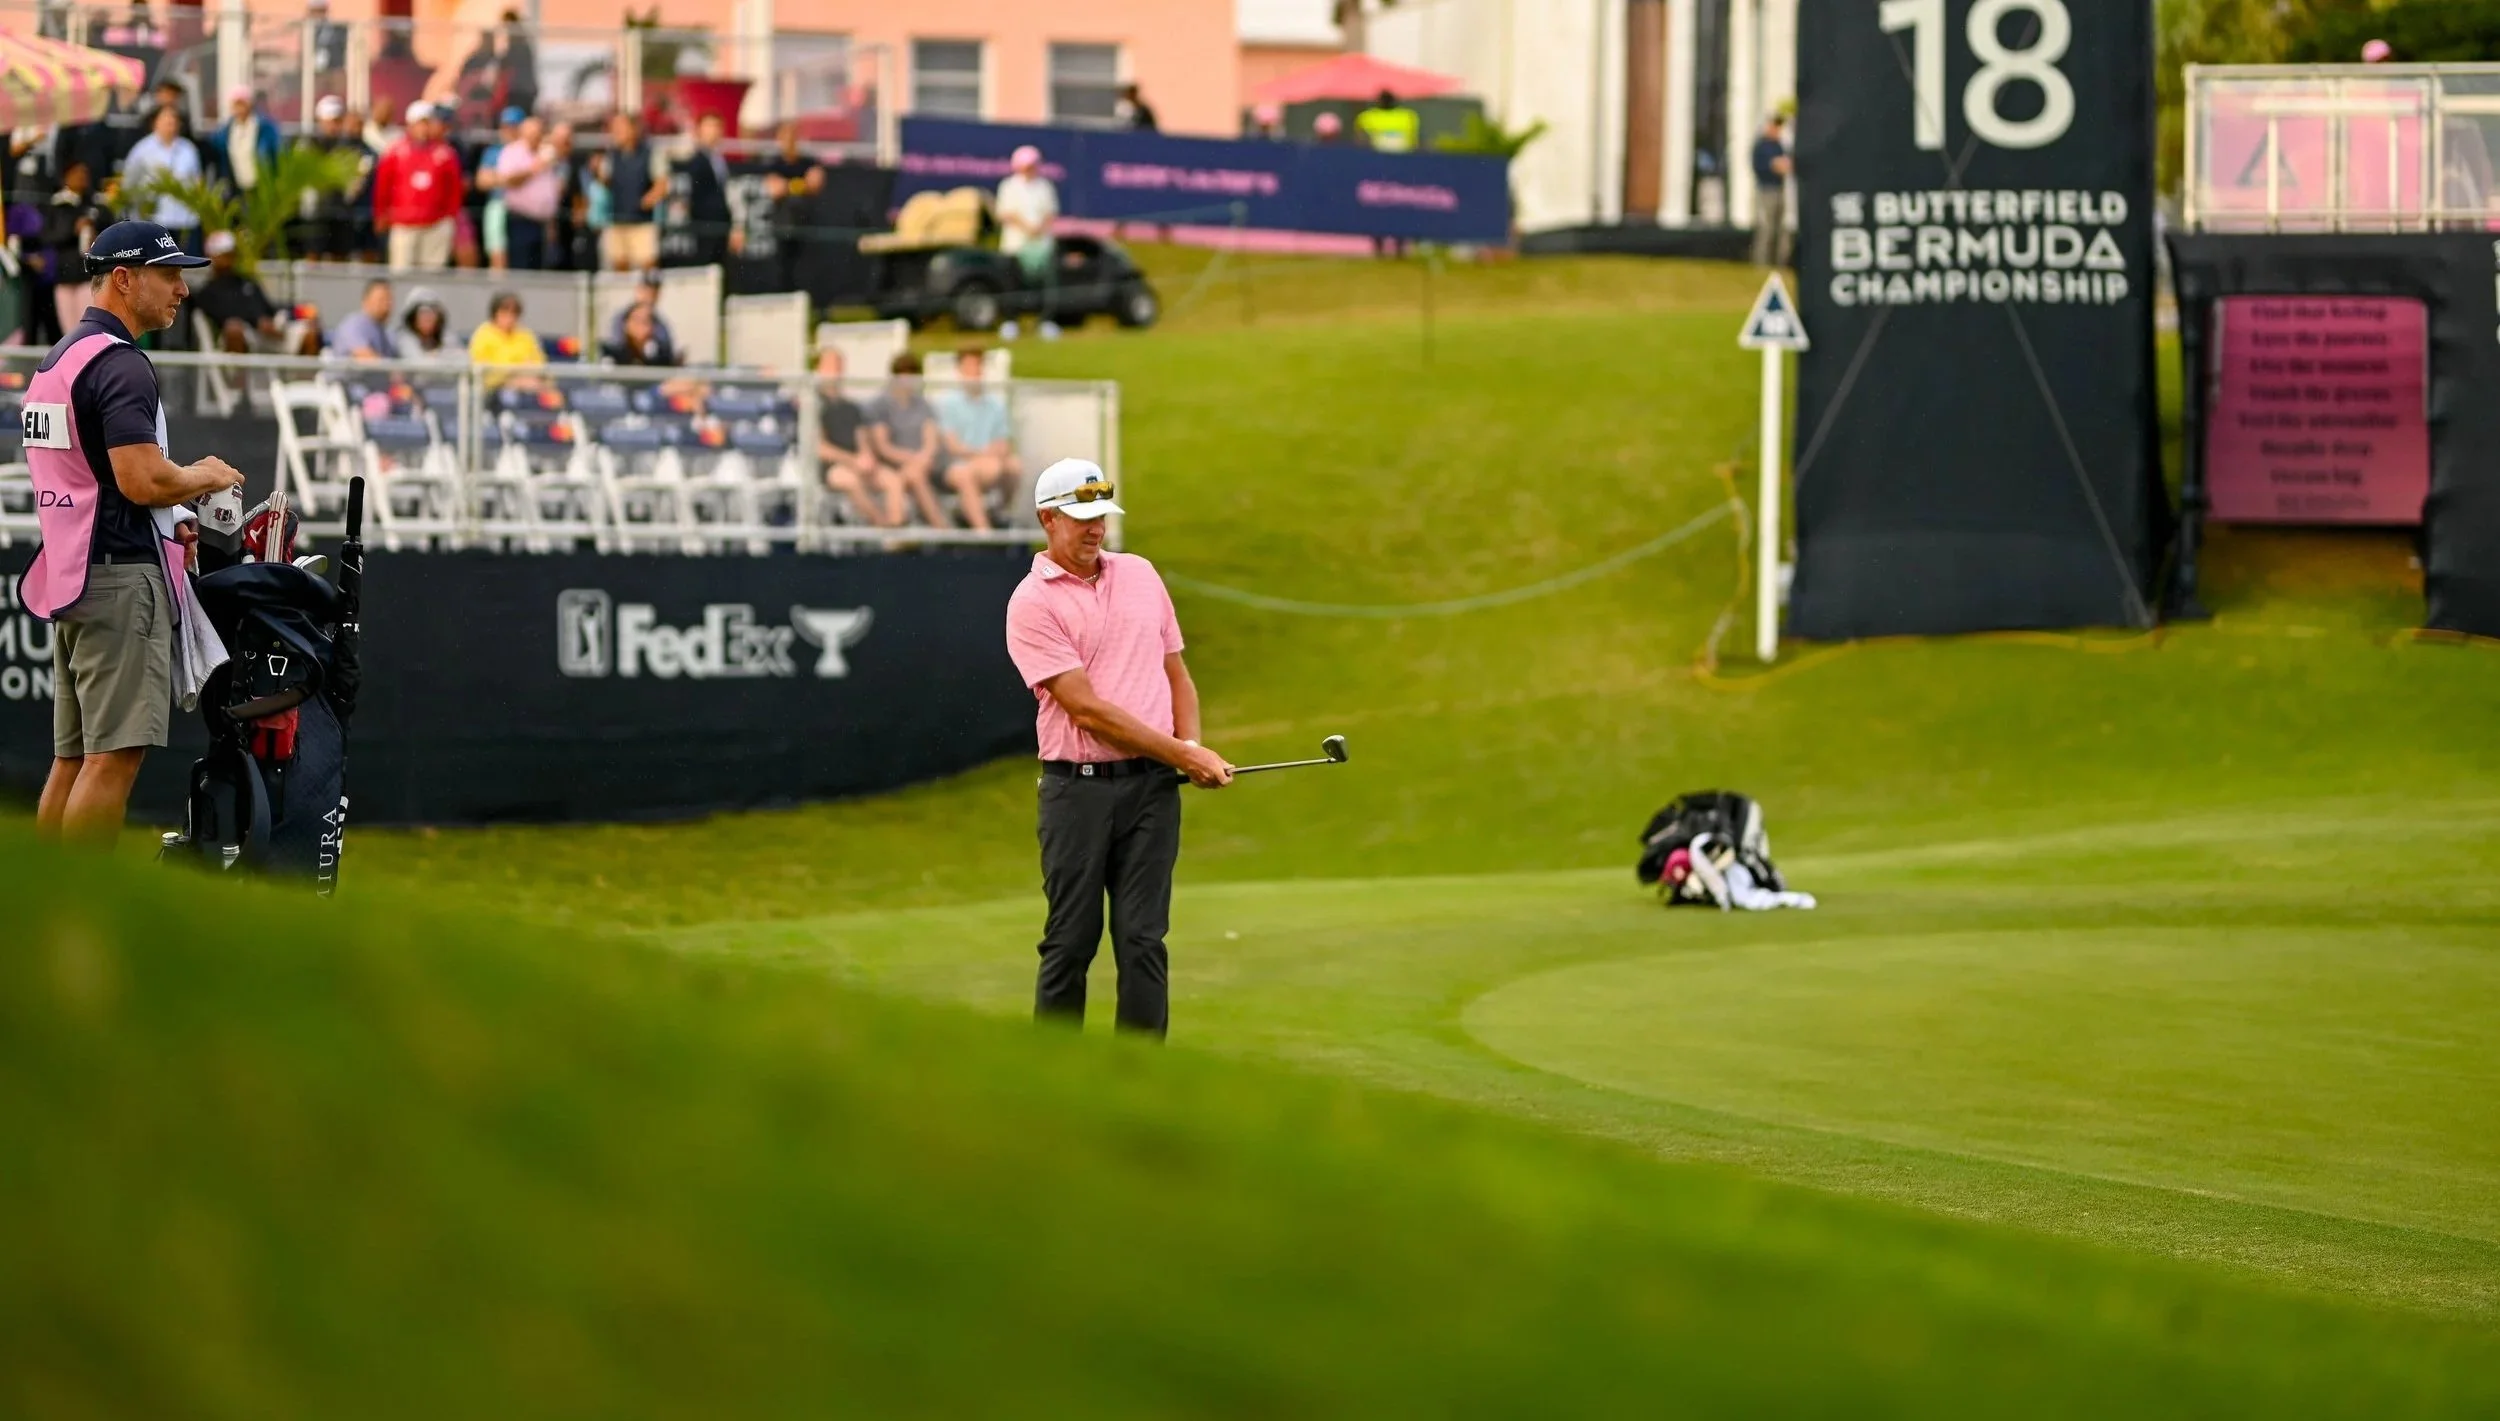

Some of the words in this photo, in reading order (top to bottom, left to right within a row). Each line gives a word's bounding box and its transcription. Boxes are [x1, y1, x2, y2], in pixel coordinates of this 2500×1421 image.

[1878, 0, 2076, 149] 18
[1873, 190, 2128, 225] BUTTERFIELD
[112, 248, 142, 258] valspar
[1830, 225, 2126, 271] BERMUDA
[1830, 270, 2129, 306] CHAMPIONSHIP
[35, 490, 74, 508] DA
[616, 603, 798, 679] FedEx
